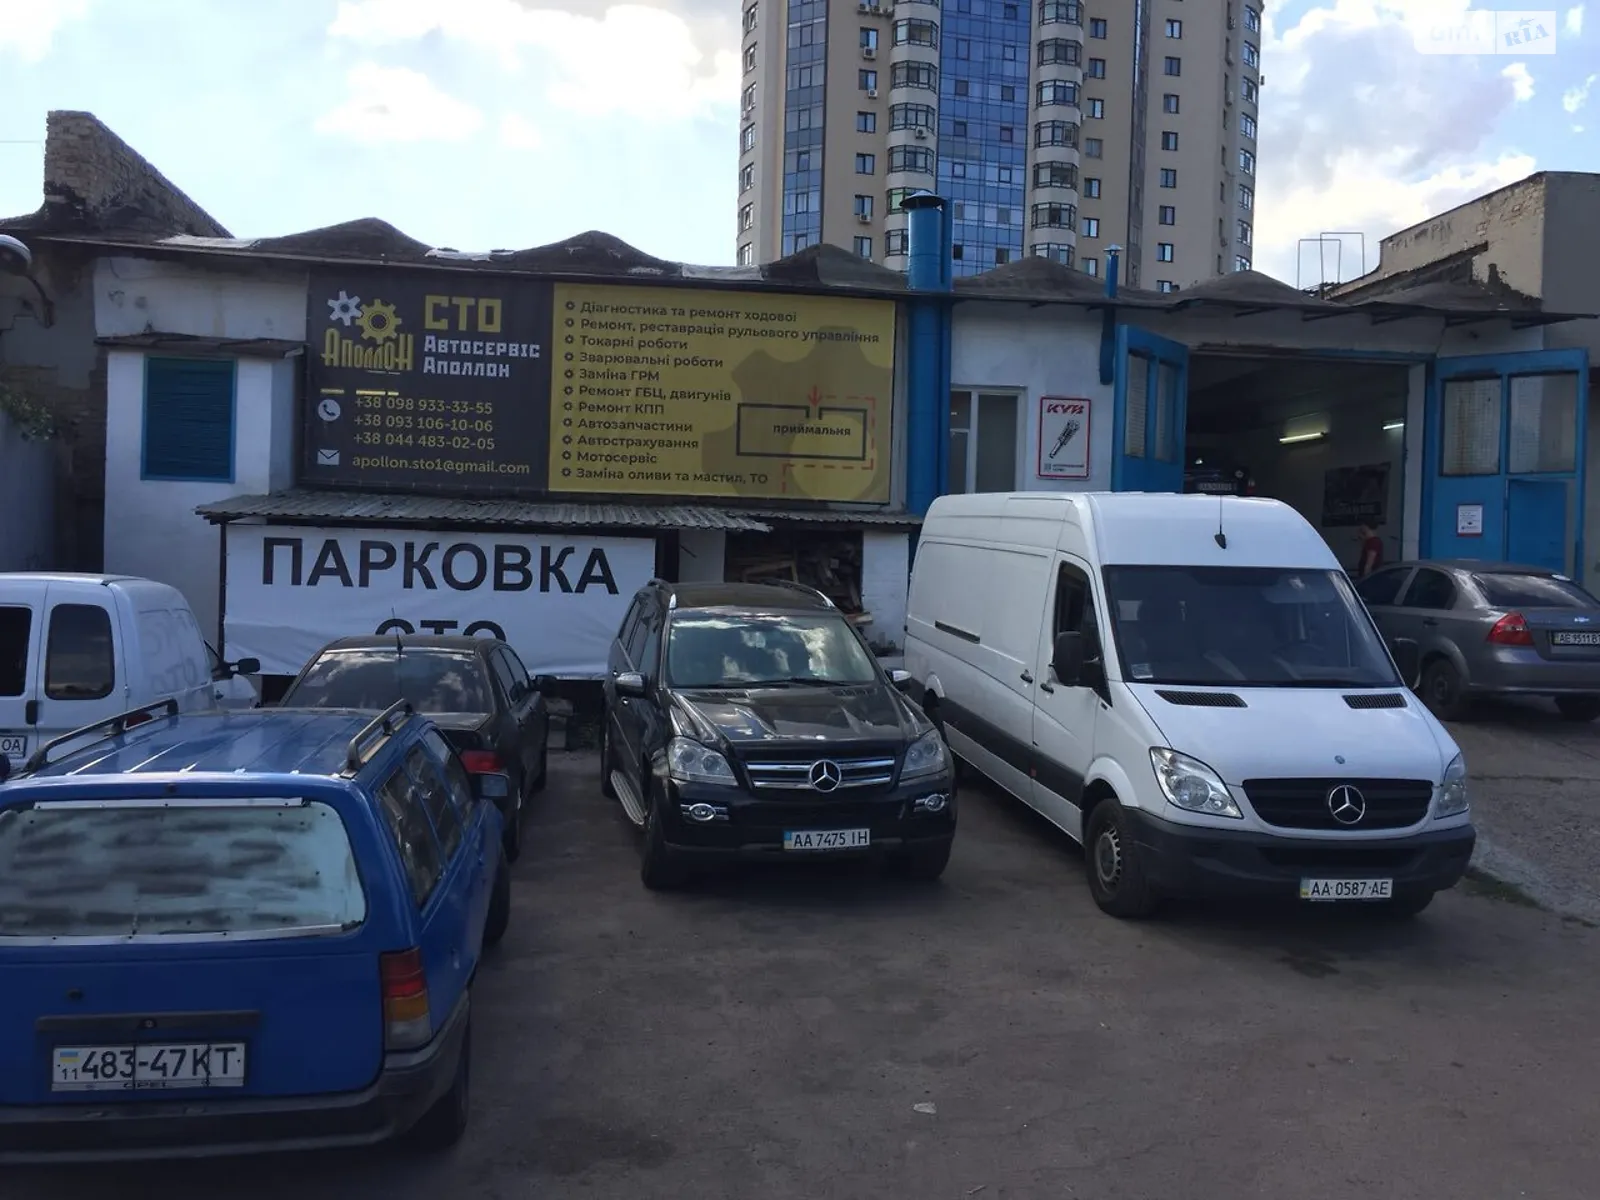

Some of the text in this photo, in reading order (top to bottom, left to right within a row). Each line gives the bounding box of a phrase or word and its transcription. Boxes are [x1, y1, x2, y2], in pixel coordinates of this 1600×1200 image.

[424, 295, 502, 332] СТО
[580, 301, 668, 316] Діагностика
[671, 307, 686, 316] та
[689, 308, 741, 319] ремонт
[581, 318, 880, 343] Ремонт, реставрація рульового управління
[580, 335, 688, 350] Токарні роботи
[579, 352, 724, 368] Зварювальні роботи
[579, 368, 660, 381] Заміна ГРМ
[579, 385, 732, 402] Ремонт ГБЦ, двигунів
[355, 396, 493, 415] +38 098 933-33-55
[579, 401, 665, 415] Ремонт КПП
[354, 415, 493, 433] +38 093 106-10-06
[577, 418, 693, 432] Автозапчастини
[773, 423, 851, 437] приймальня
[353, 433, 495, 450] +38 044 483-02-05
[577, 435, 699, 450] Автострахування
[352, 456, 531, 475] apollon.sto1@gmail.com
[577, 452, 657, 465] Мотосервіс
[576, 467, 768, 485] Заміна оливи та мастил, ТО
[263, 537, 619, 595] ПАРКОВКА
[794, 830, 867, 847] AA 7475 IH
[1311, 882, 1389, 895] AA 0587 AE
[62, 1068, 78, 1080] 11
